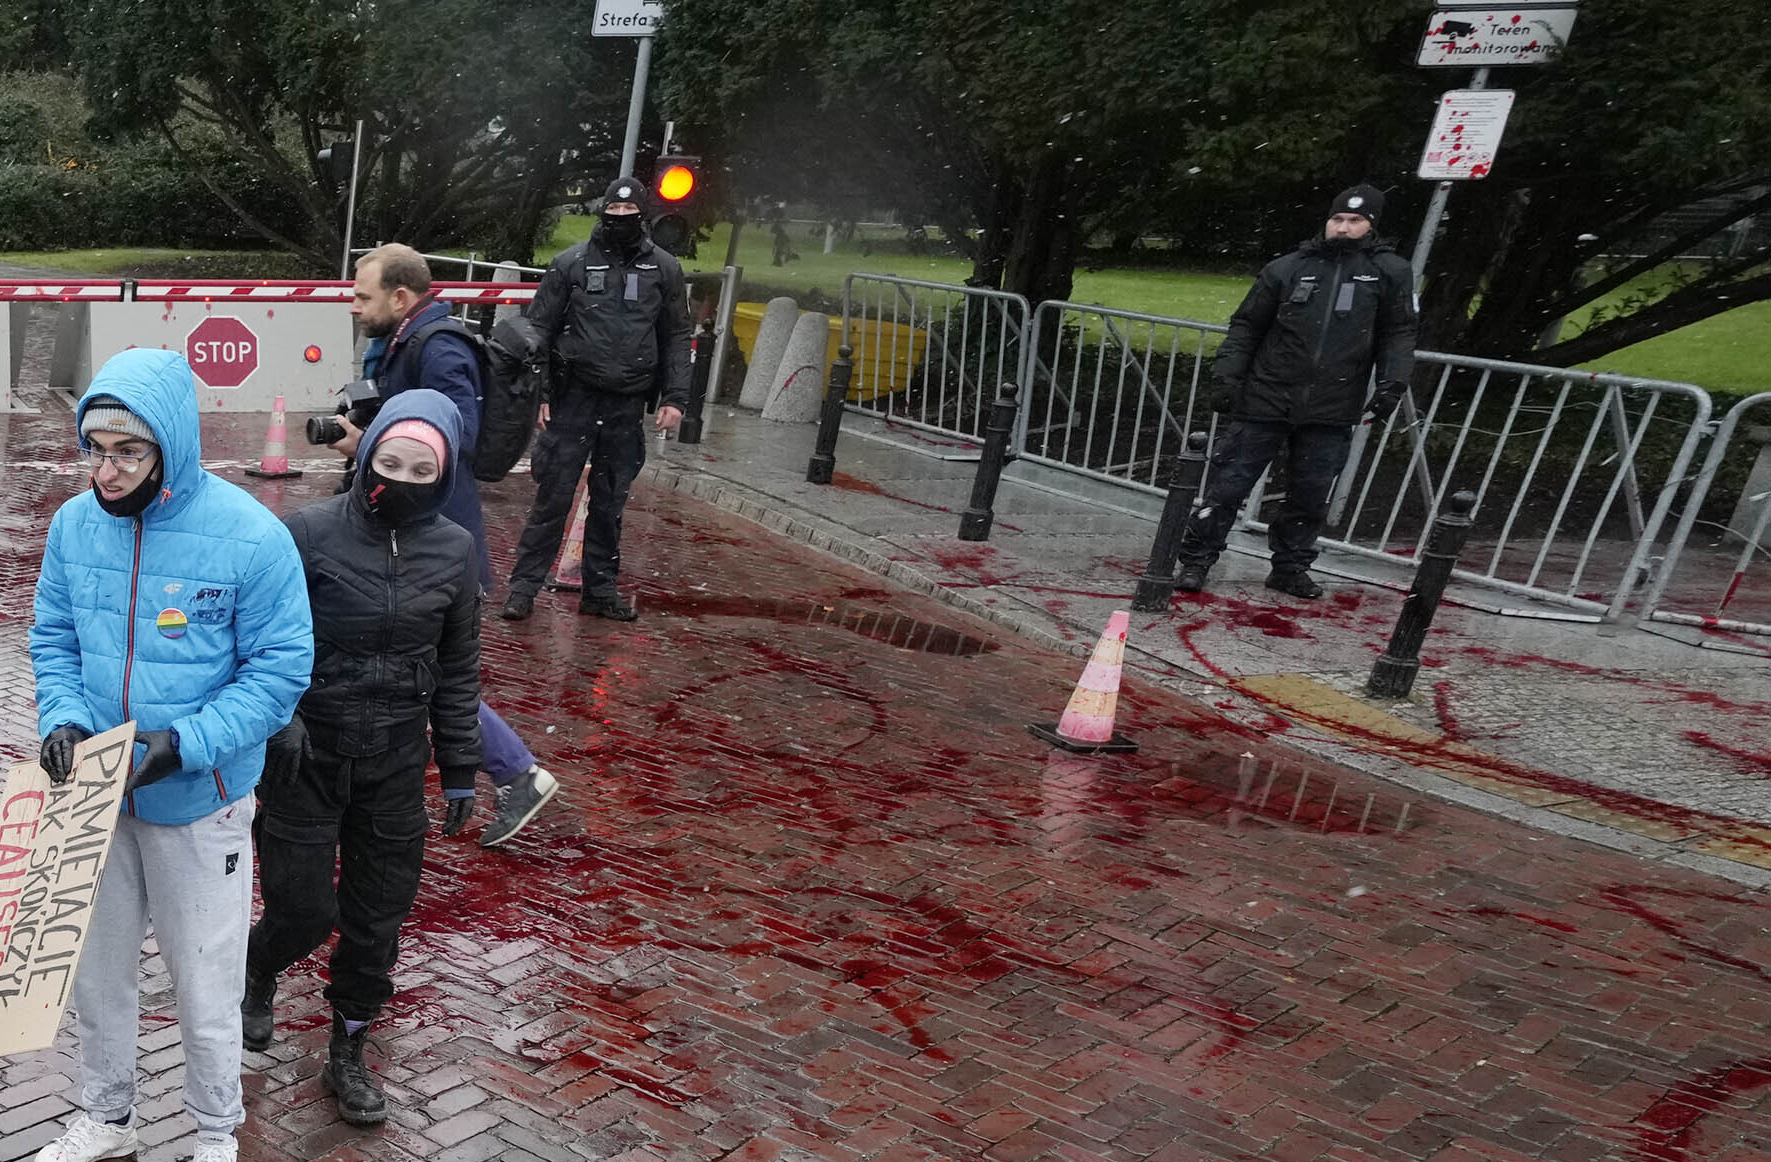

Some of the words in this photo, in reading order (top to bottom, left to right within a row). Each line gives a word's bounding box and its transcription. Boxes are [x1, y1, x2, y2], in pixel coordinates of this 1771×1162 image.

[600, 12, 648, 27] Strefa
[1491, 23, 1531, 36] Teren
[1453, 41, 1557, 54] monitorowan
[194, 341, 252, 363] STOP
